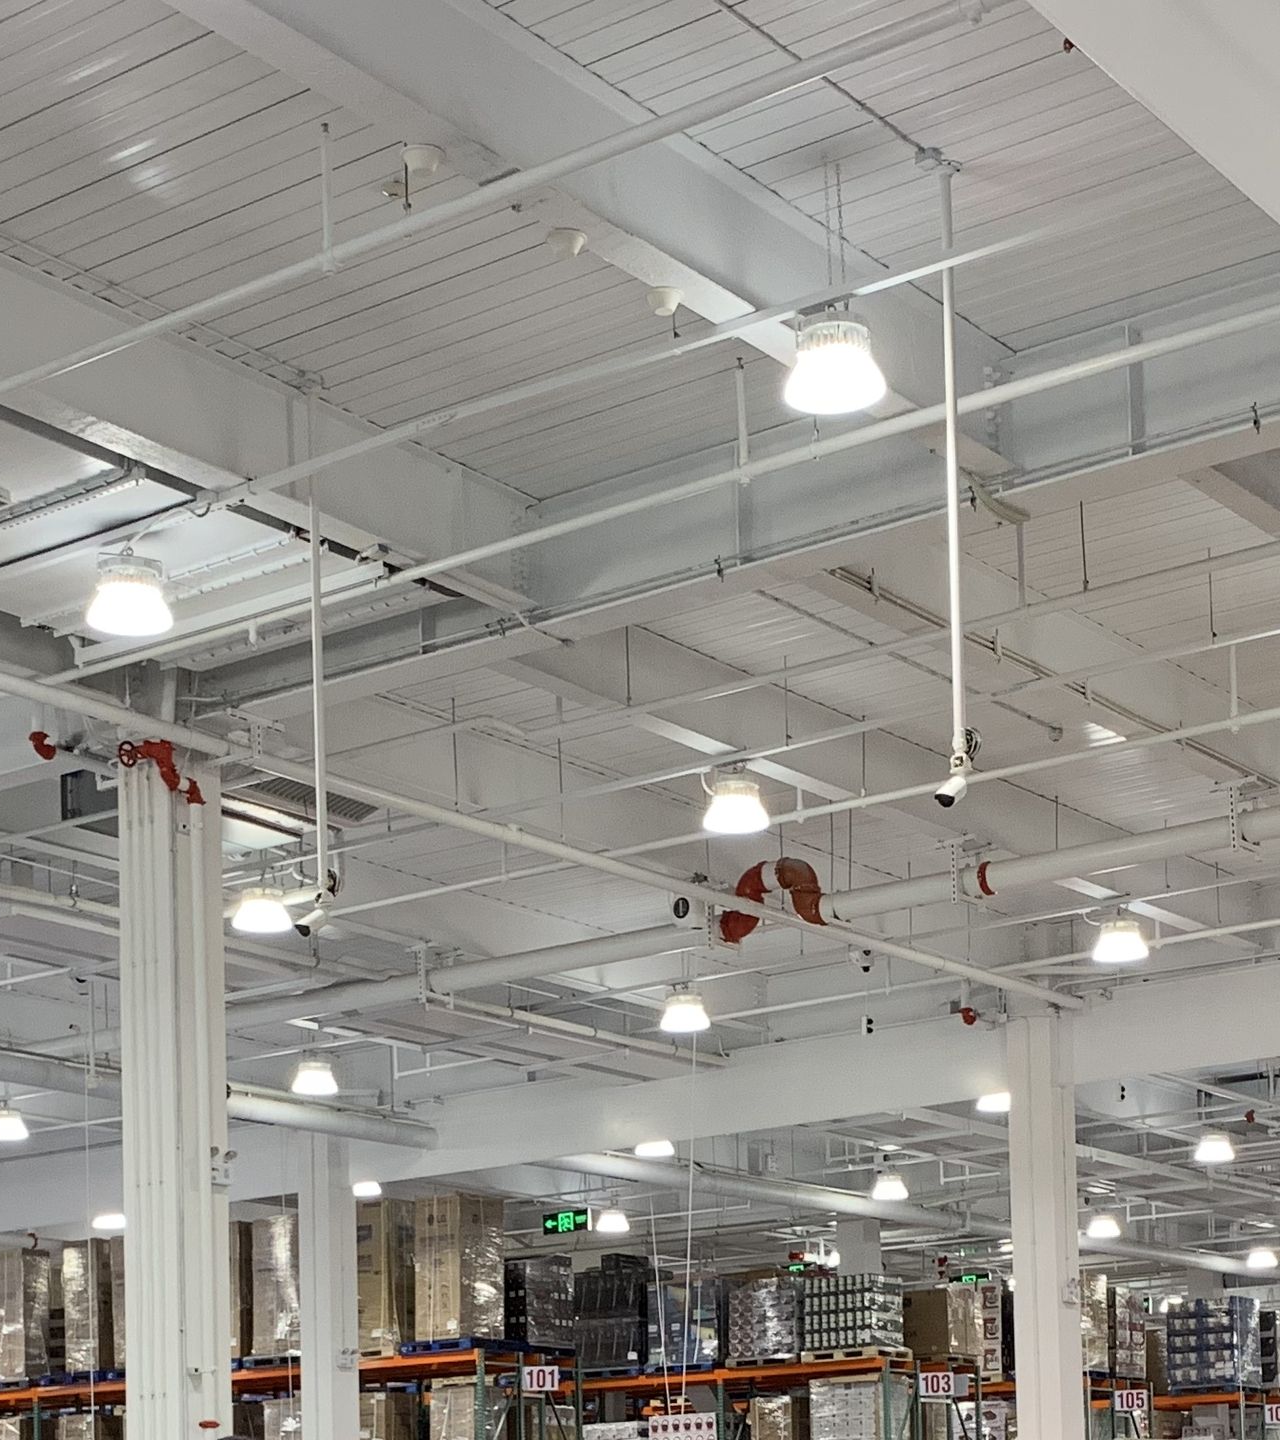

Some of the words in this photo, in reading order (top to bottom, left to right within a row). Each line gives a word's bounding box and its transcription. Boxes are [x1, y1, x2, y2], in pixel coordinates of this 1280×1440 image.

[526, 1368, 555, 1389] 101
[922, 1373, 952, 1394] 103
[1117, 1391, 1145, 1409] 105
